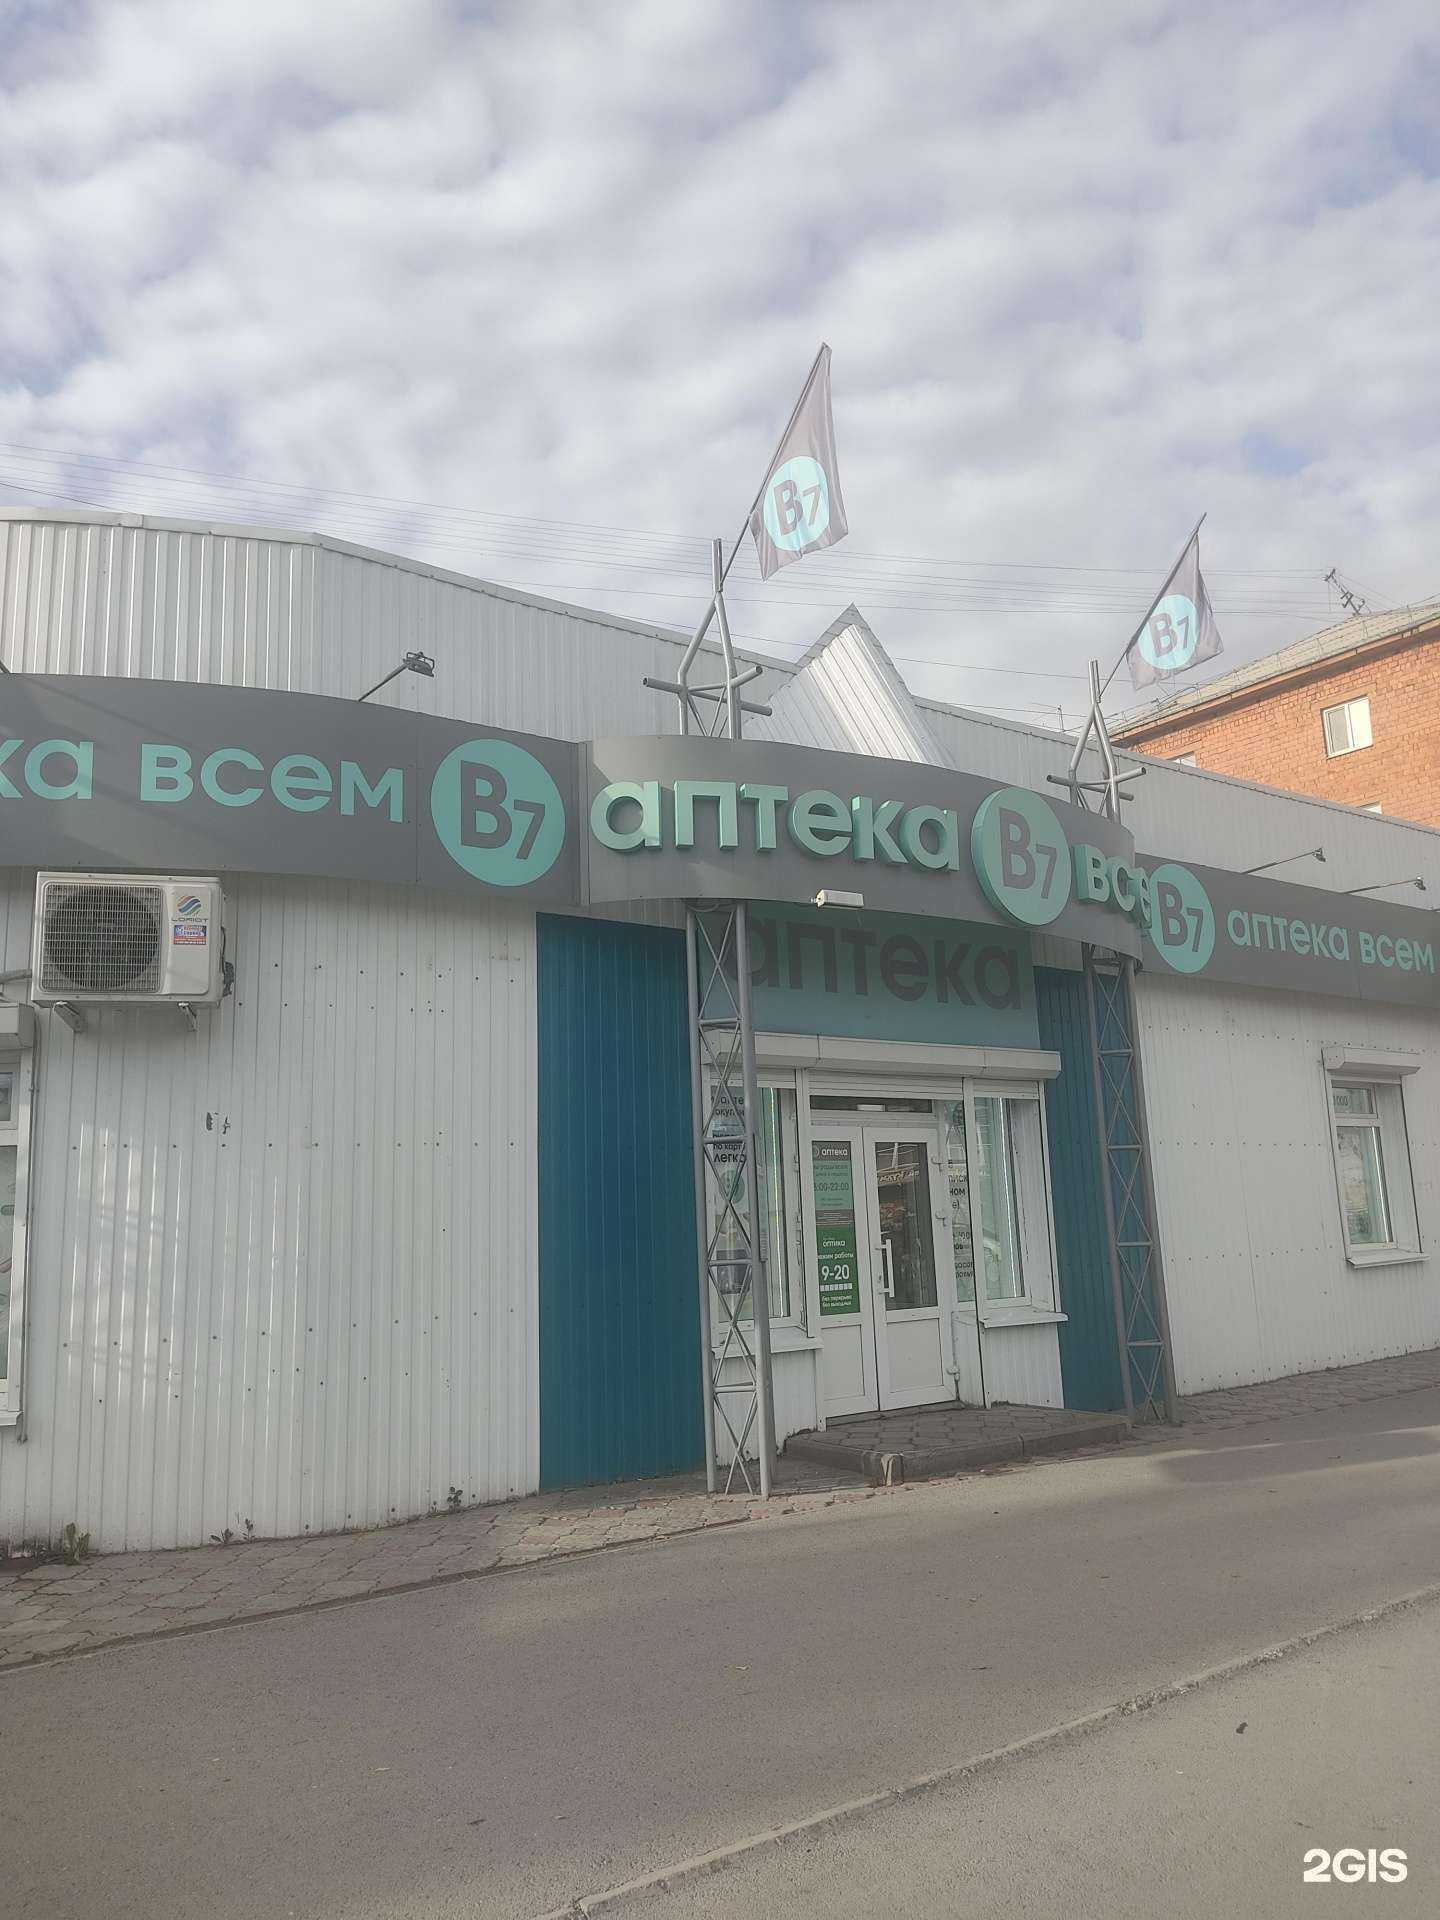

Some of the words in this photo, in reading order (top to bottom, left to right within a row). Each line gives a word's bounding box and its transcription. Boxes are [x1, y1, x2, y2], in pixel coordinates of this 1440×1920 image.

[140, 743, 404, 823] всем
[590, 780, 960, 872] аптека
[1227, 910, 1350, 961] аптека
[1359, 931, 1435, 974] всем
[821, 1148, 848, 1156] аптека
[821, 1264, 850, 1281] 9-20
